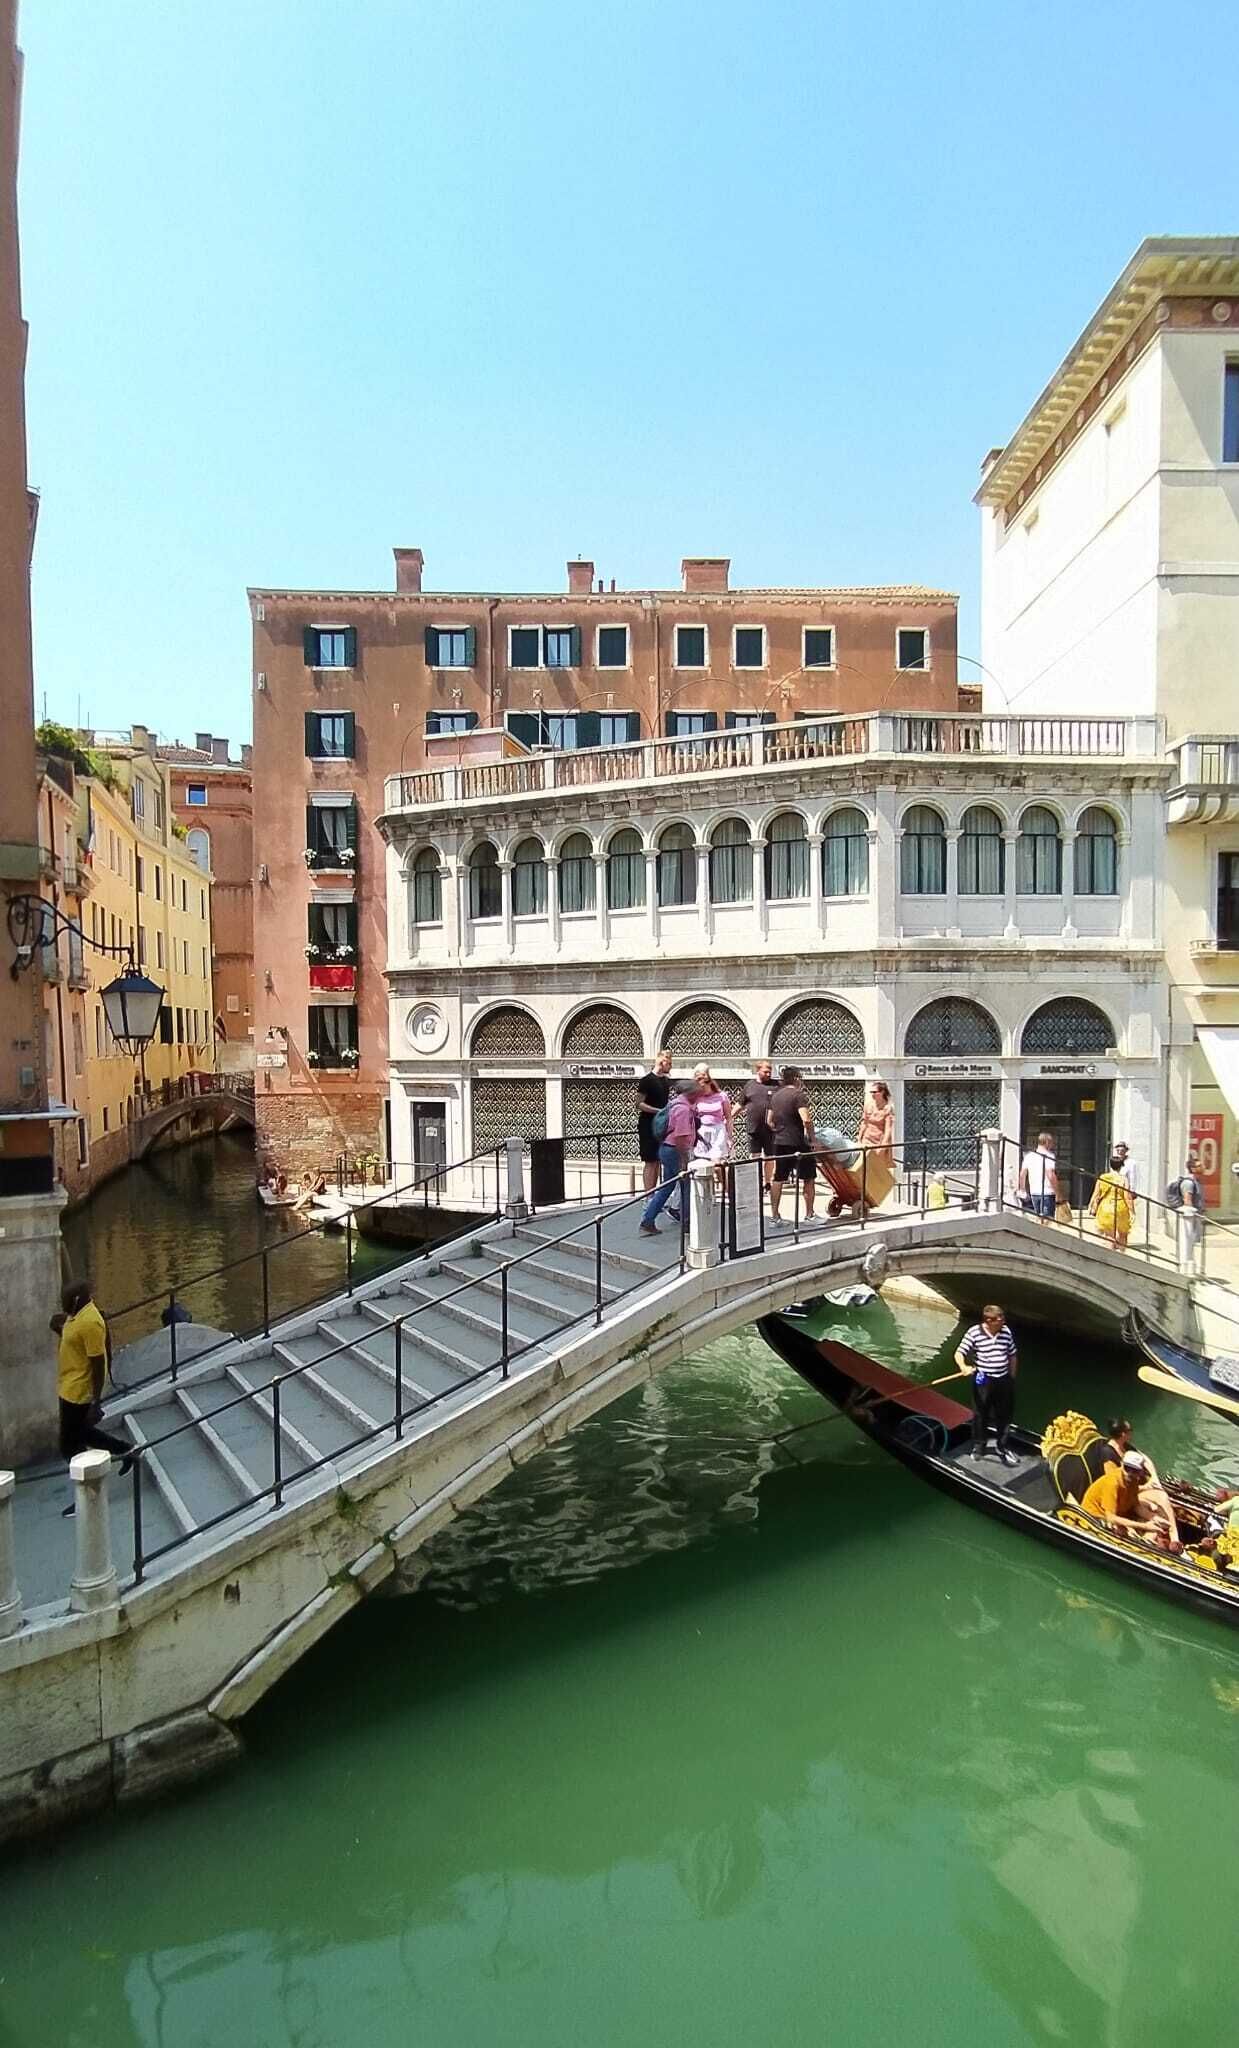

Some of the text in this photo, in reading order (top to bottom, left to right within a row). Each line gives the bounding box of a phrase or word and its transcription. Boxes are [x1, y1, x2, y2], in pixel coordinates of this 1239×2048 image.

[600, 1064, 614, 1072] della
[616, 1064, 635, 1072] Marca
[813, 1064, 830, 1072] della
[833, 1064, 854, 1072] Marca
[951, 1064, 968, 1072] della
[970, 1064, 992, 1072] Marca
[1190, 1119, 1216, 1131] ALDI
